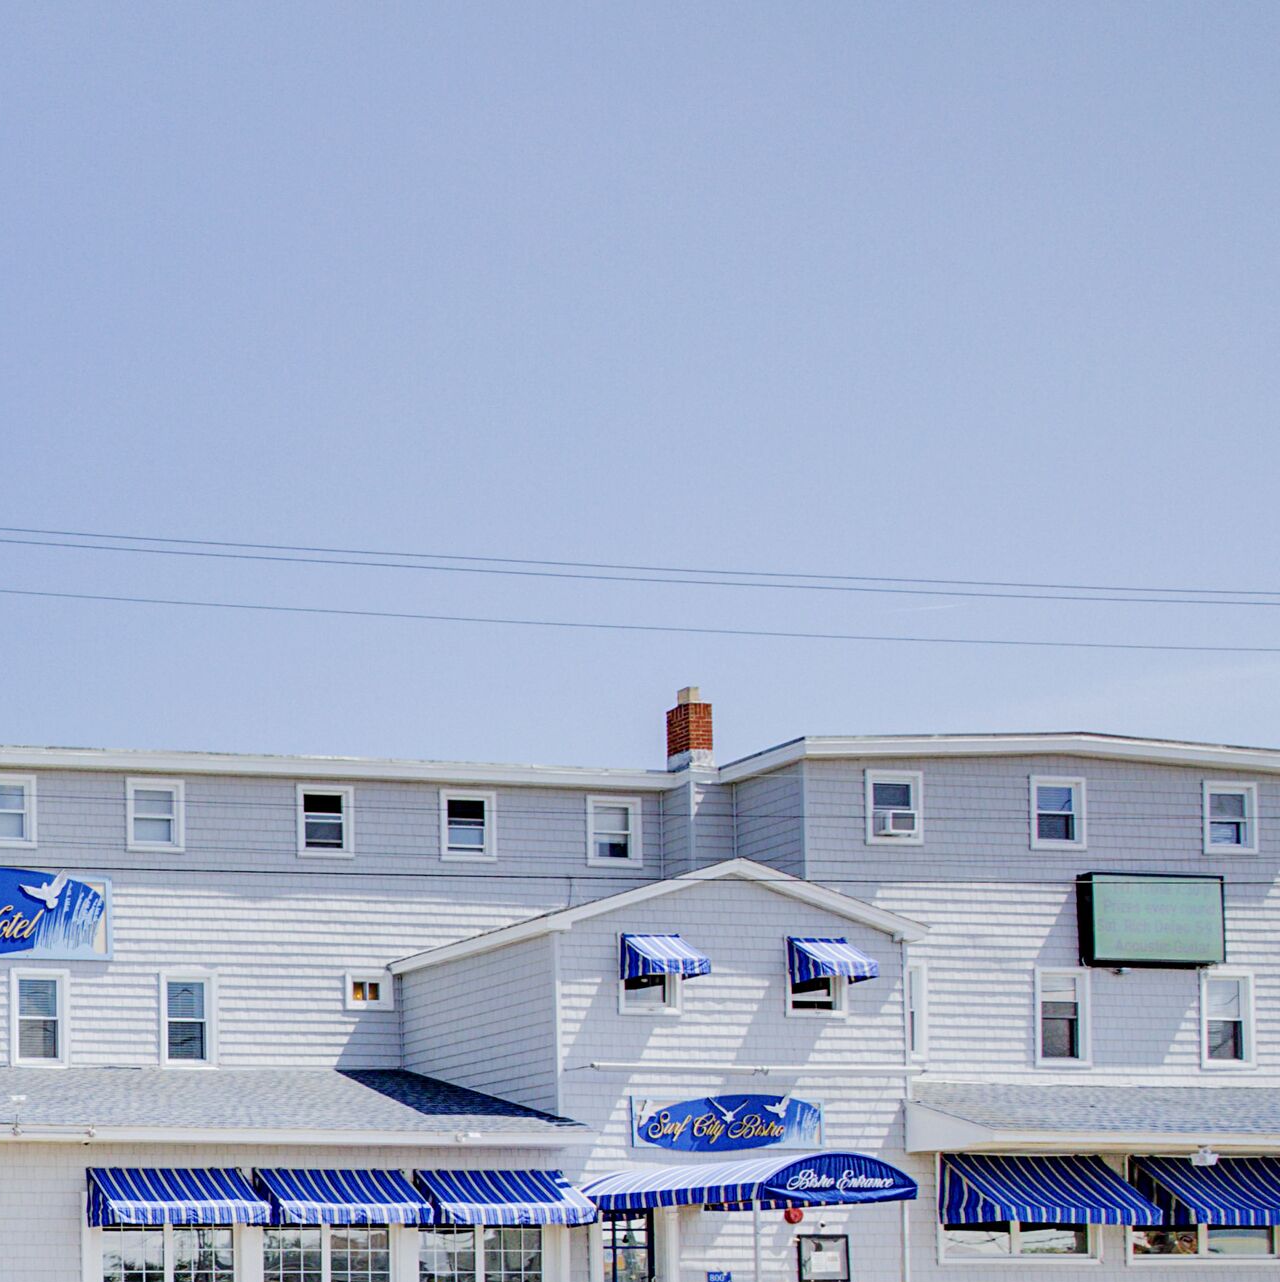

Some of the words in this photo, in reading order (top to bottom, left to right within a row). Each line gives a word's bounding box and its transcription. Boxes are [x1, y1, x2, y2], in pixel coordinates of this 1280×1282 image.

[648, 1111, 691, 1142] Surf
[693, 1113, 725, 1144] City
[727, 1114, 786, 1139] Bistro
[786, 1168, 835, 1190] Bistro
[836, 1169, 894, 1194] Entrance
[709, 1274, 724, 1282] 800
